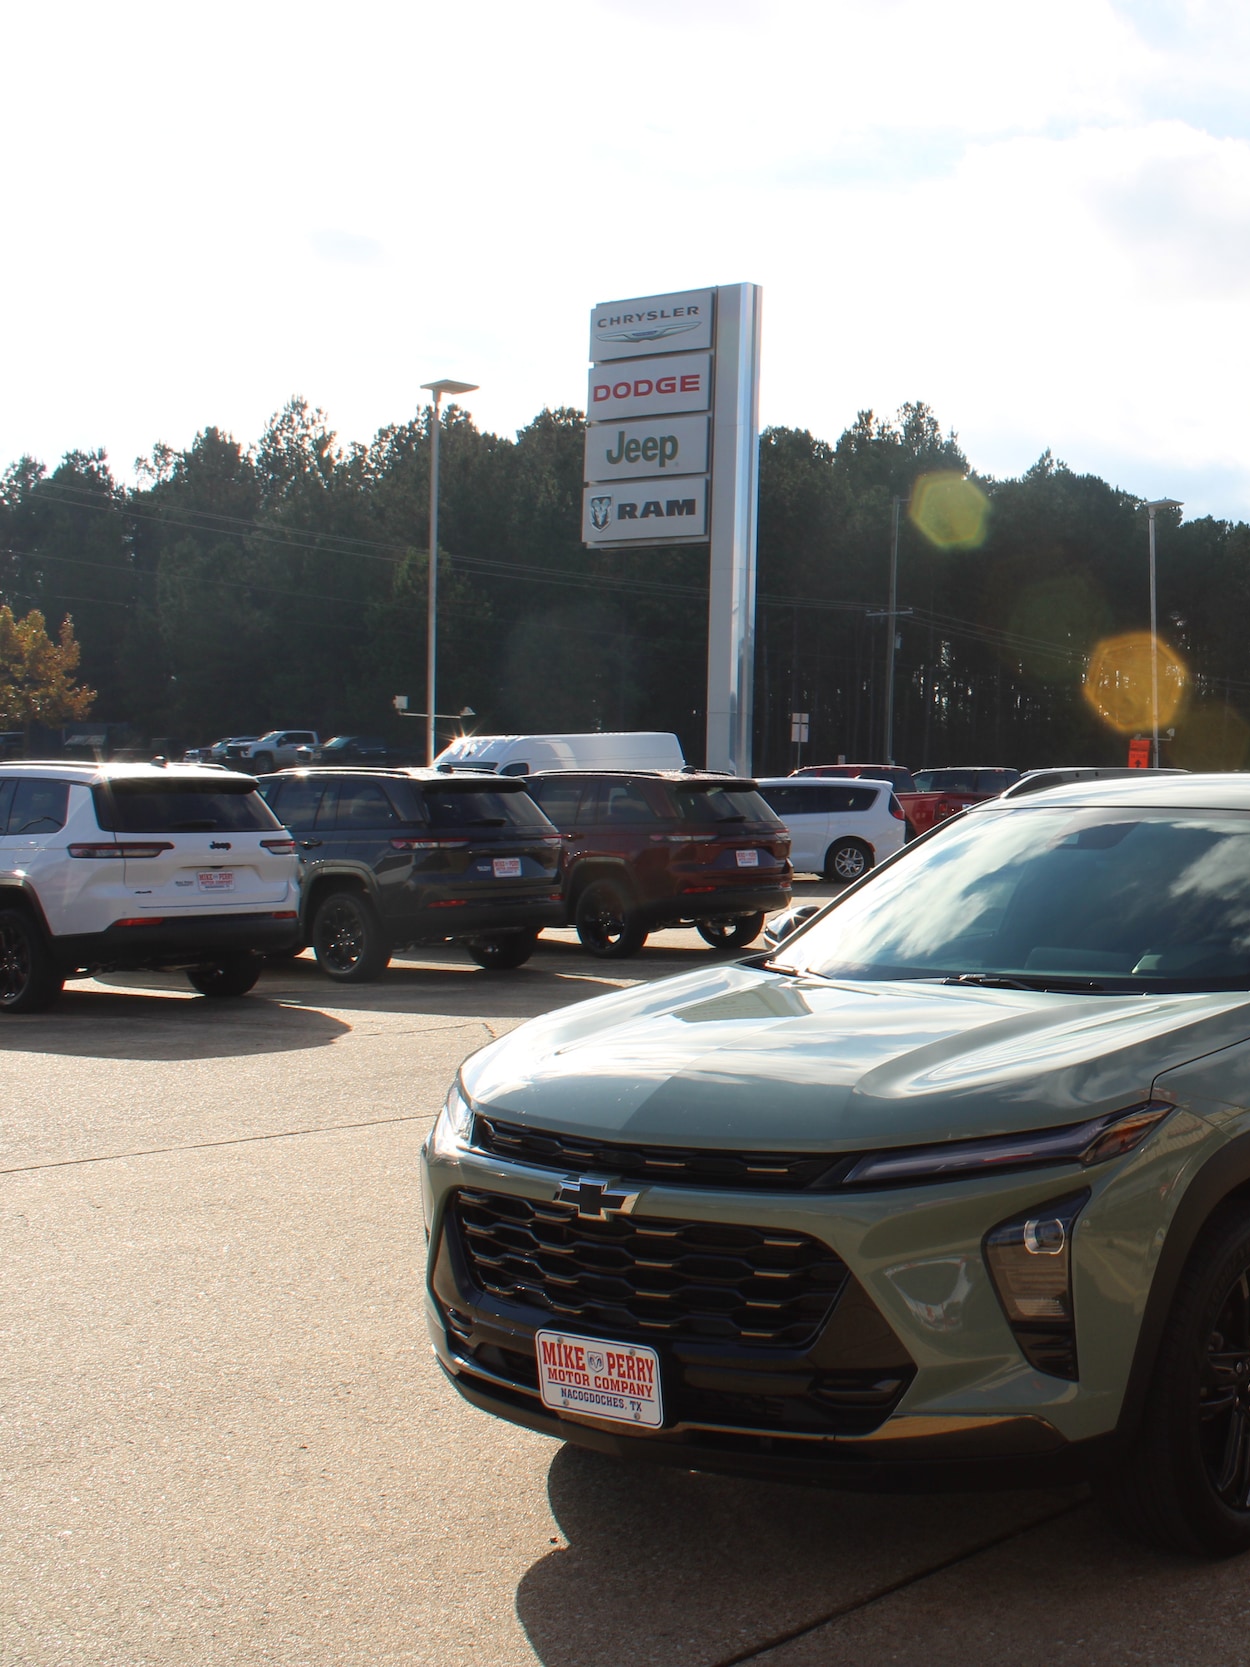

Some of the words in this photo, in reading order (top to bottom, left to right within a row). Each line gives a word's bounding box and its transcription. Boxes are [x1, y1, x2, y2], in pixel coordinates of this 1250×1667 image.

[597, 306, 699, 328] CHRYSLER
[593, 374, 700, 402] DODGE
[606, 431, 679, 468] Jeep
[617, 499, 696, 520] RAM
[542, 1341, 586, 1371] MIKE
[606, 1352, 654, 1384] PERRY
[548, 1368, 590, 1386] MOTOR
[594, 1375, 652, 1398] COMPANY
[630, 1401, 642, 1412] TX
